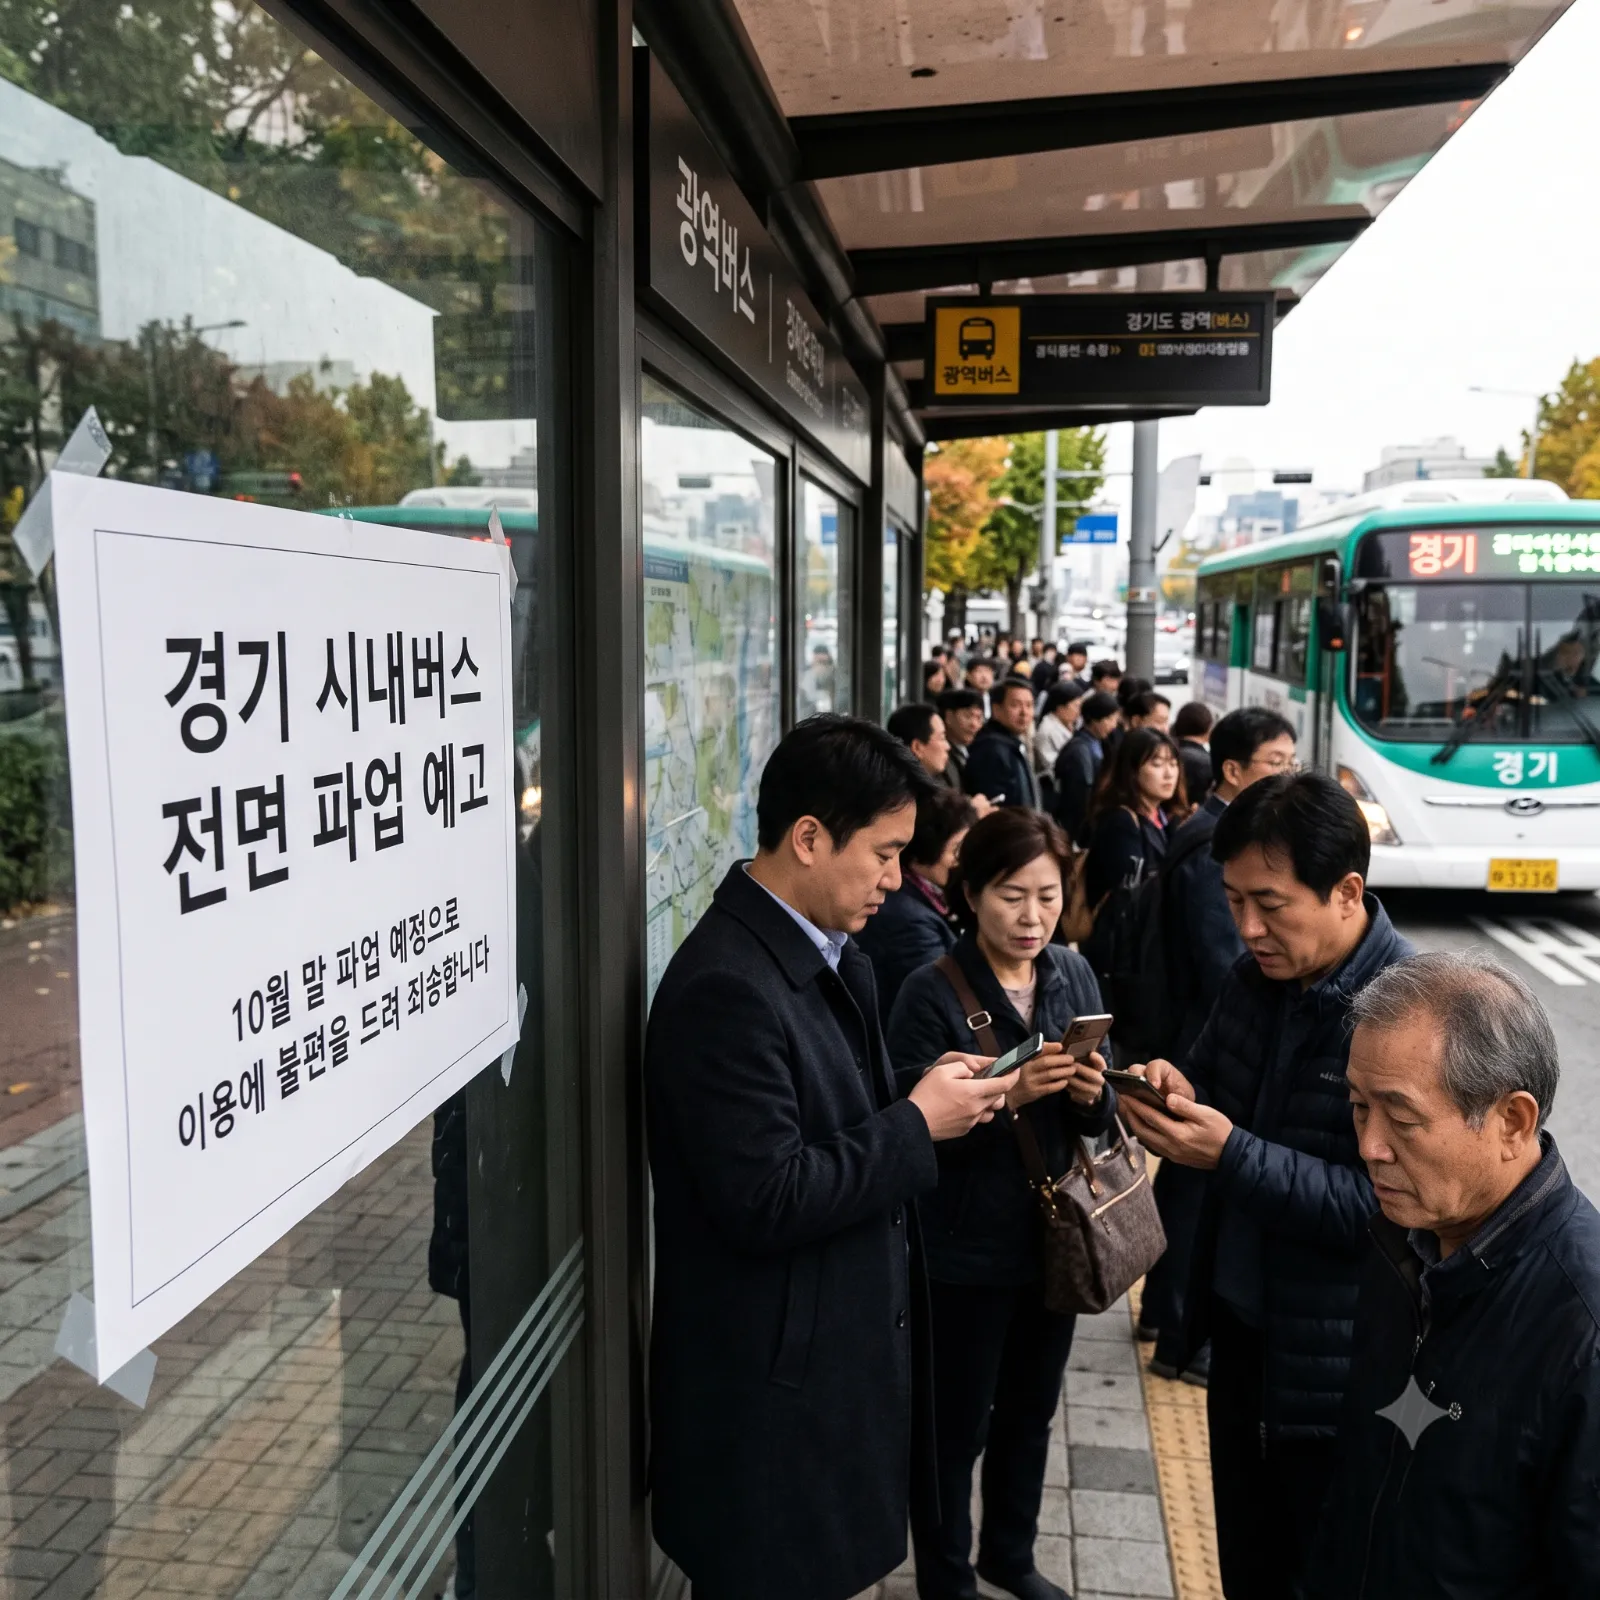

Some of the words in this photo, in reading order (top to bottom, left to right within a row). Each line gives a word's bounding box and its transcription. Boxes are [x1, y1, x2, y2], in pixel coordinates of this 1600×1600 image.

[676, 155, 756, 325] 광역버스
[942, 366, 1013, 386] 광역버스
[1126, 311, 1175, 331] 경기도
[1408, 533, 1478, 576] 경기
[164, 631, 290, 754] 경기
[315, 630, 482, 733] 시내버스
[161, 773, 290, 915] 전면
[313, 751, 405, 863] 파업
[423, 742, 489, 829] 예고
[1492, 751, 1558, 785] 경기
[231, 969, 292, 1043] 10월
[302, 954, 327, 1012] 말
[336, 930, 381, 989] 파업
[389, 896, 460, 965] 예정으로
[178, 1058, 266, 1151] 이용에
[276, 1014, 350, 1100] 불편을
[360, 985, 400, 1045] 드려
[407, 934, 490, 1016] 죄송합니다
